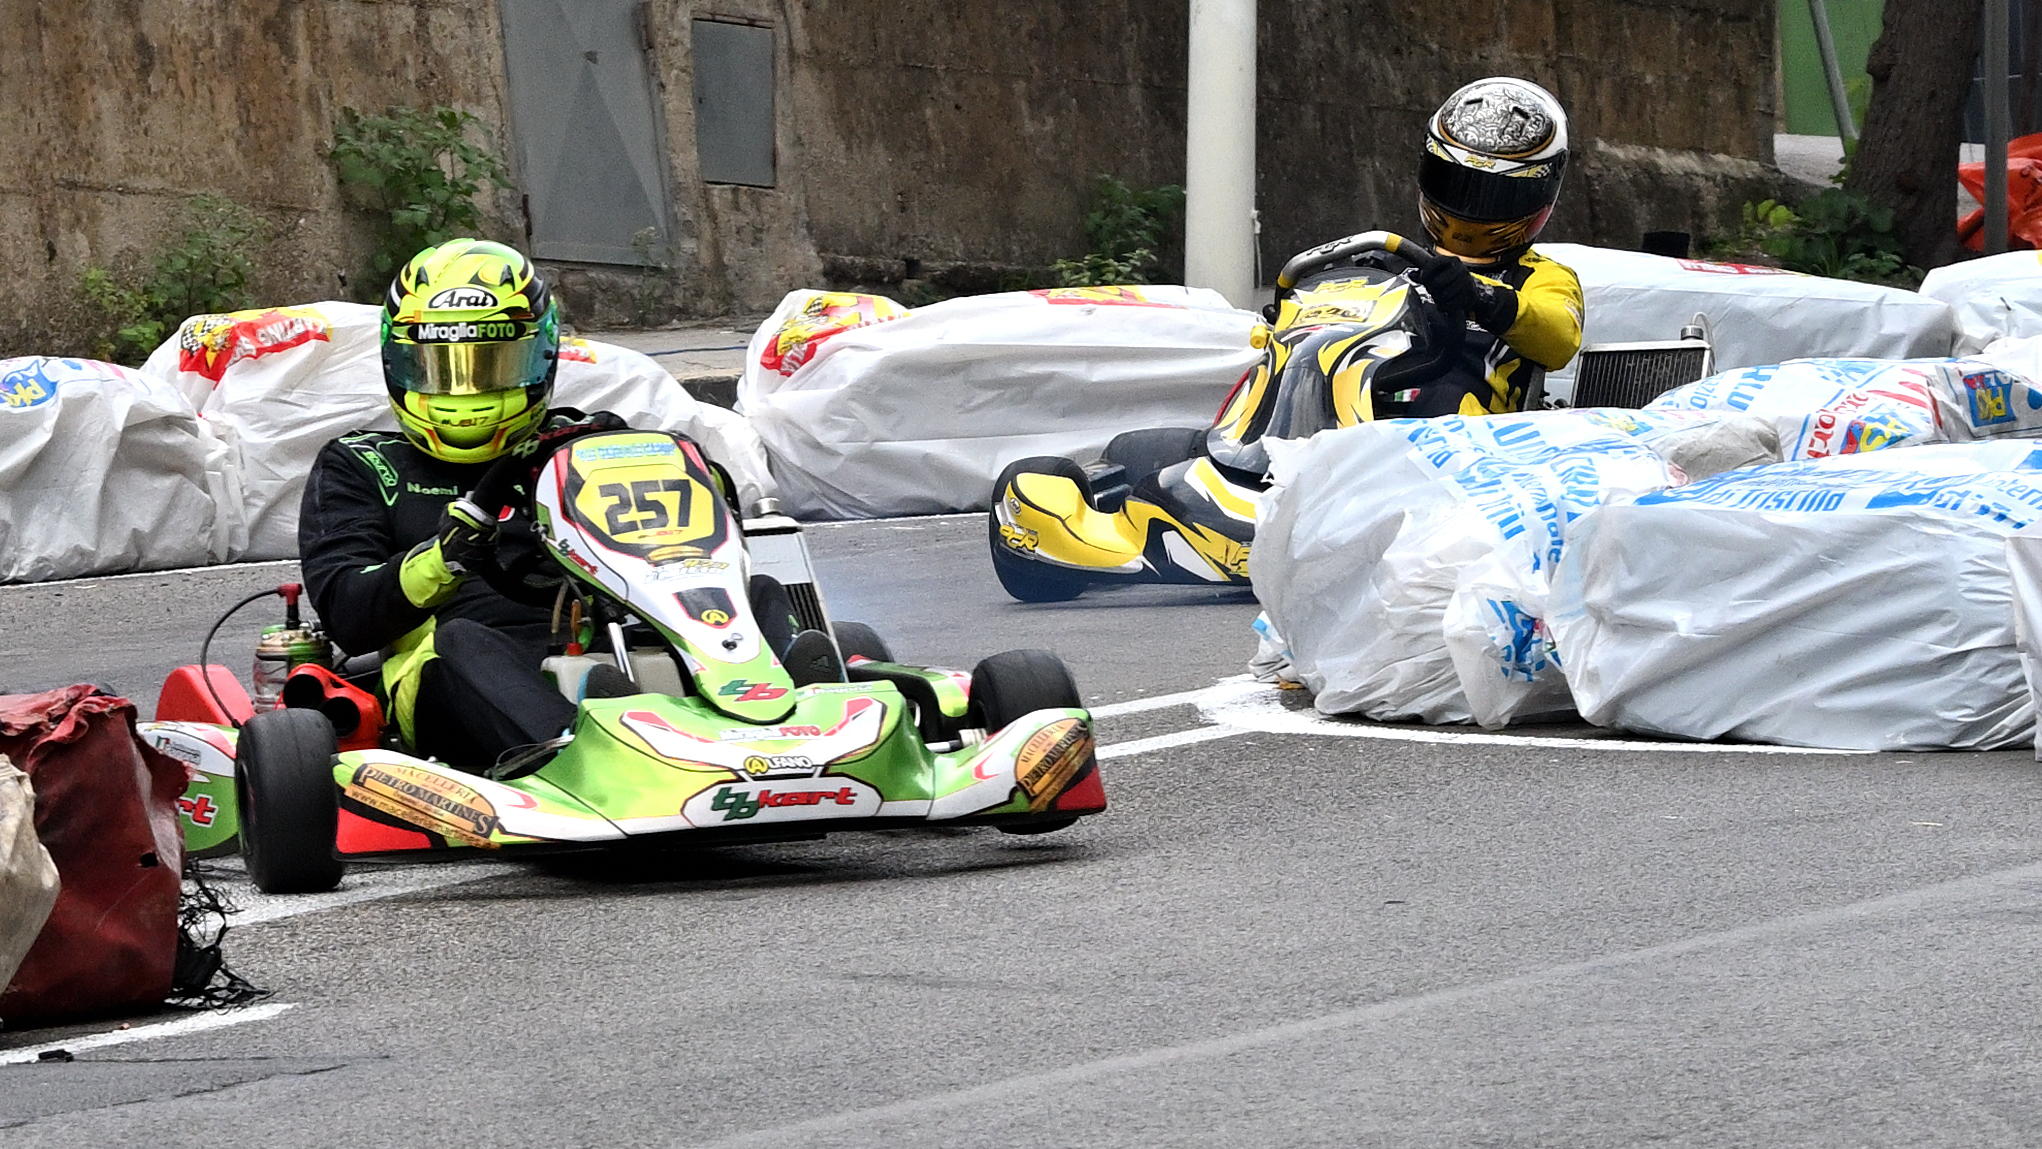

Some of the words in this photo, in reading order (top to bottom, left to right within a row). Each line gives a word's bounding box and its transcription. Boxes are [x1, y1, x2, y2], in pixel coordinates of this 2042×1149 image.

[436, 290, 491, 308] Arai
[598, 478, 693, 537] 257
[395, 766, 478, 805] MACELLERIA
